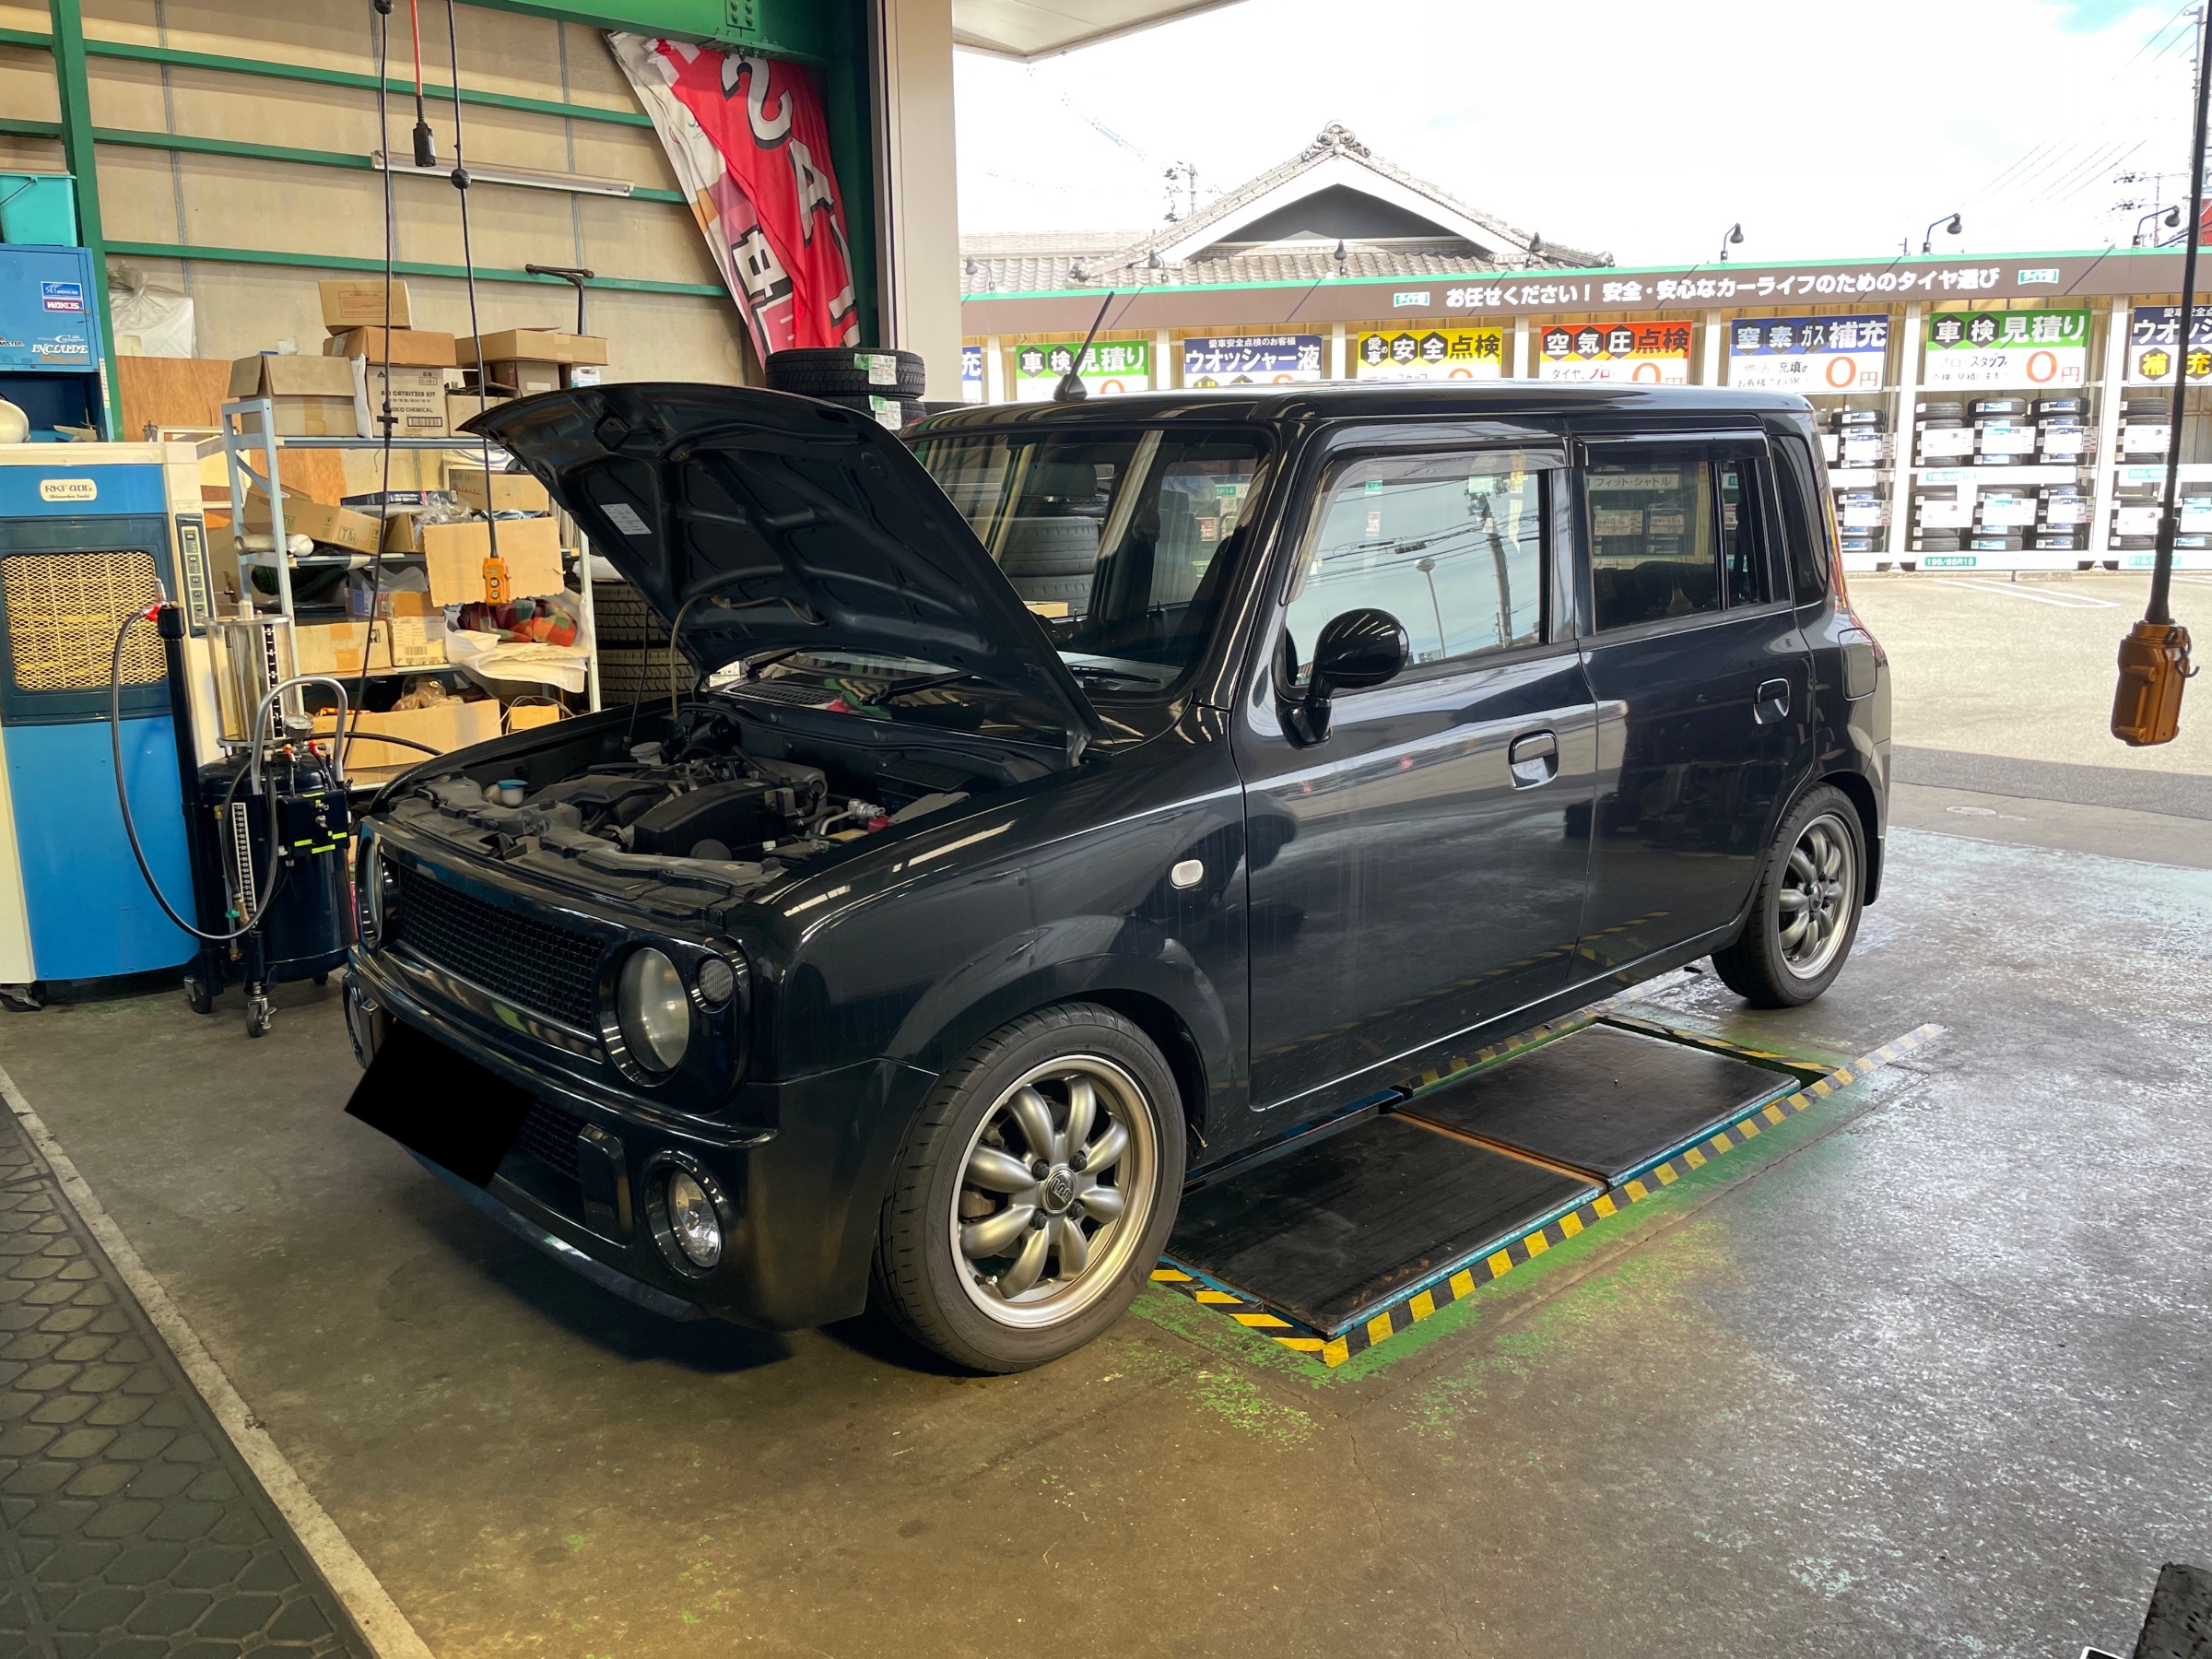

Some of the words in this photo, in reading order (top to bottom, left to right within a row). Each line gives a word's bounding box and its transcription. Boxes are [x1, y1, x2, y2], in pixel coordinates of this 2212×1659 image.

[1208, 336, 1297, 348] 愛車安全点検のお客様
[1546, 327, 1690, 355] 空気圧点検
[1736, 320, 1887, 349] 窒素ガス補充
[1936, 315, 2084, 344] 車検見積り
[31, 344, 88, 356] INCLUDE
[1022, 347, 1144, 372] 車検見積り
[1594, 477, 1671, 488] フィット・シャトル
